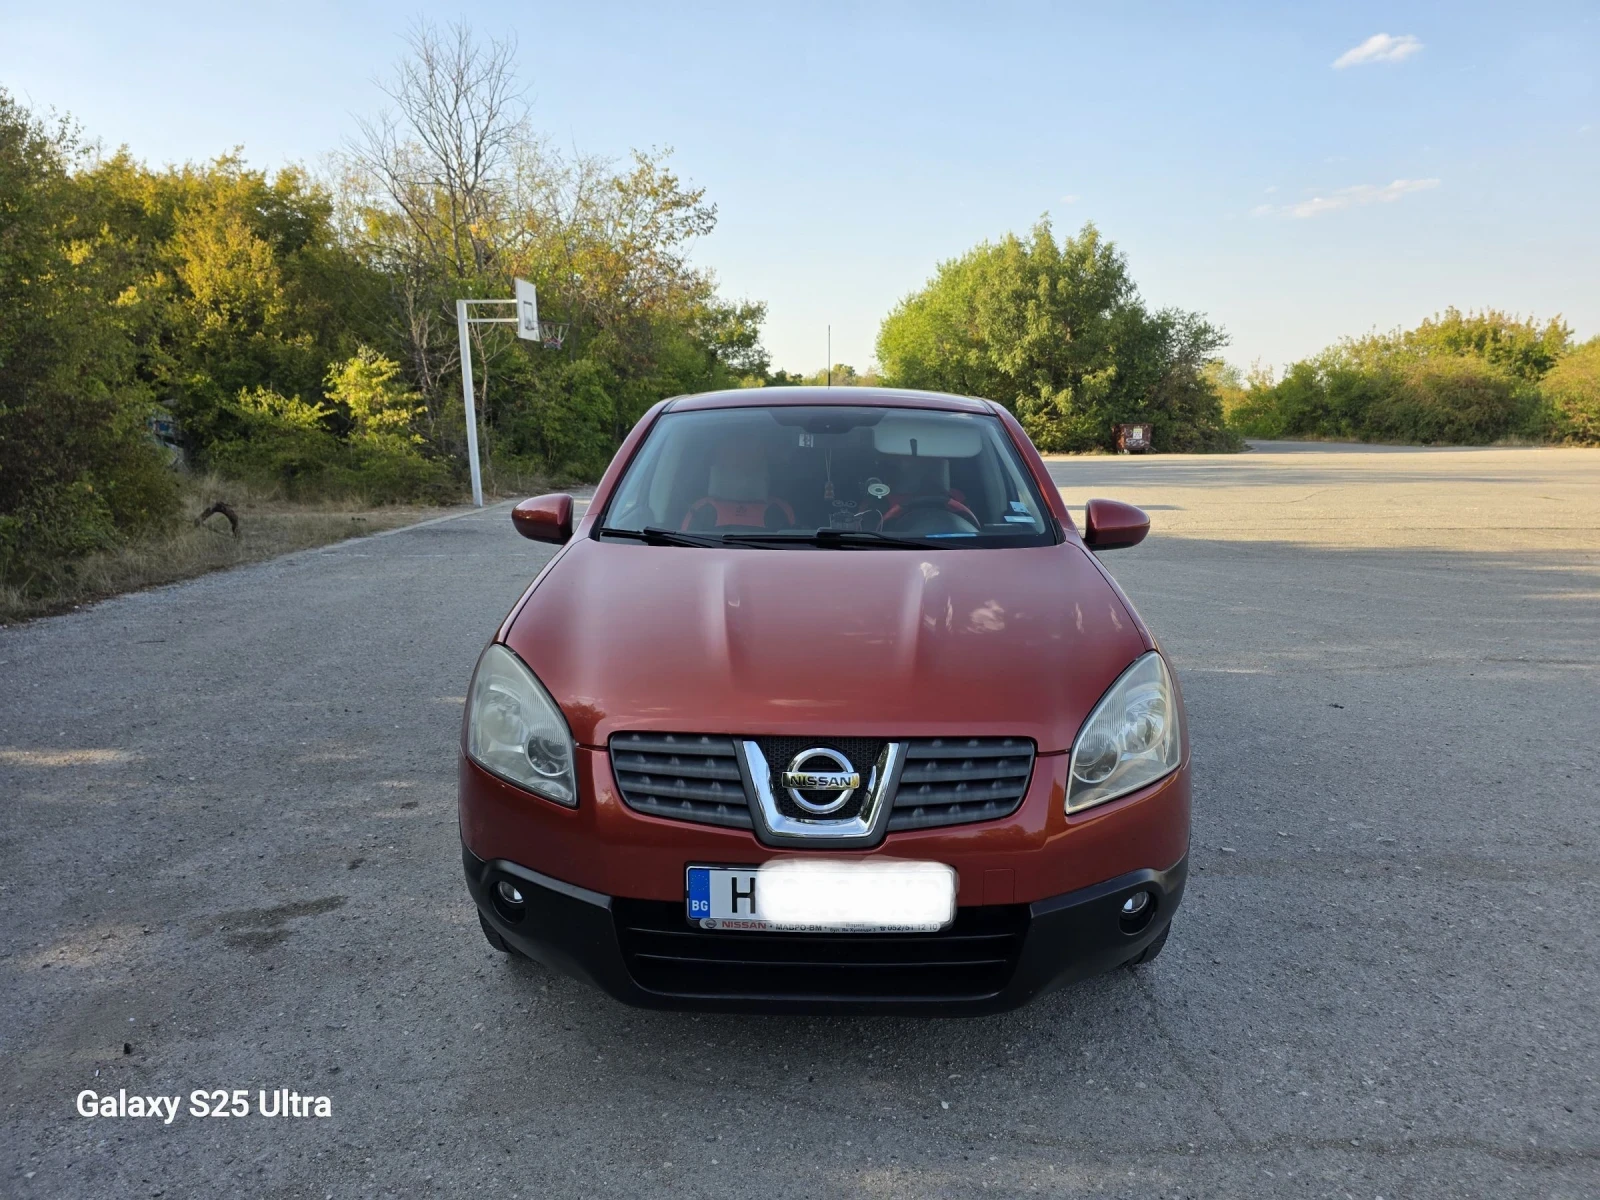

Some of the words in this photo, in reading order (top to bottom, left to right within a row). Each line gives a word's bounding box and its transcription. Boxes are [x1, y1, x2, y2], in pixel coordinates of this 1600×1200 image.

[790, 776, 851, 787] NISSAN
[732, 877, 756, 914] H
[691, 900, 709, 911] BG
[722, 920, 767, 929] NISSAN
[929, 923, 938, 931] 10
